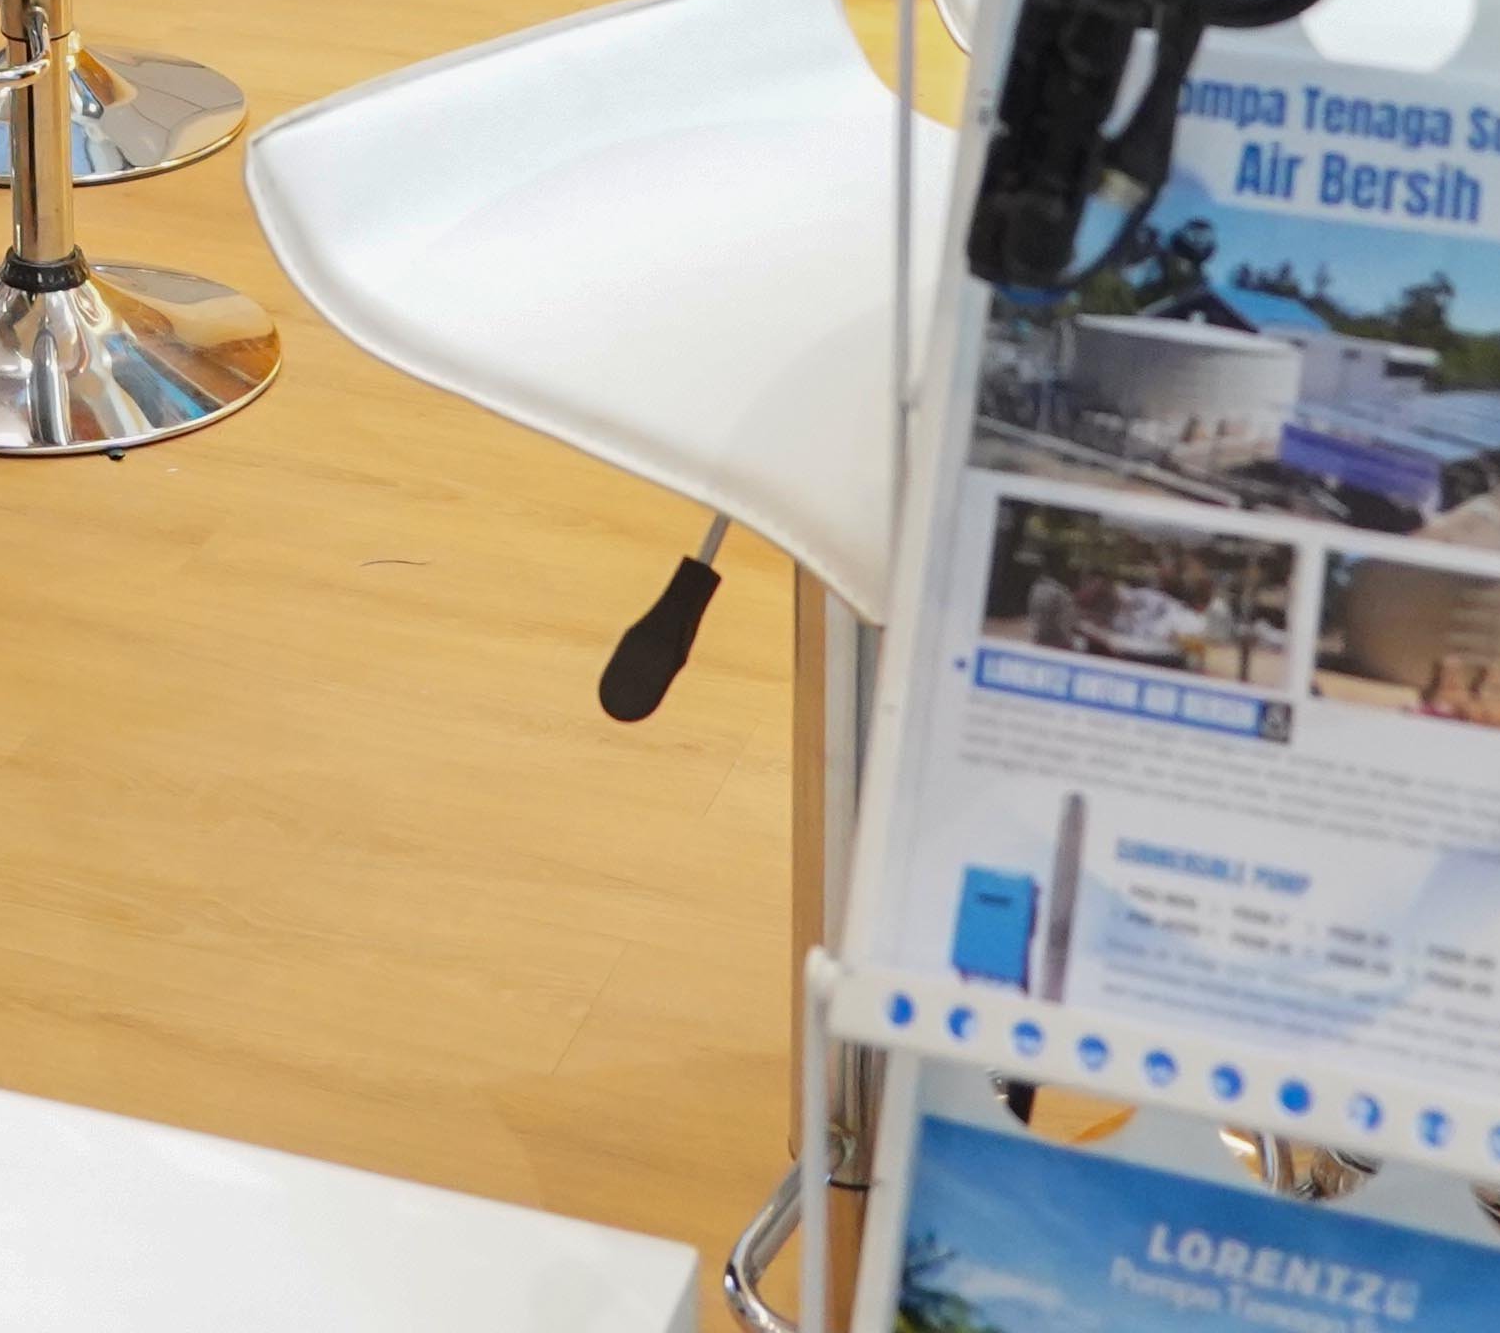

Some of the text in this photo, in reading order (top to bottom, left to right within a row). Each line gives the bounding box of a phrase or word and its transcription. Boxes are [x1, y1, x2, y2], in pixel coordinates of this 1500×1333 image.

[1180, 75, 1287, 130] ompa
[1303, 83, 1454, 149] Tenaga
[1235, 140, 1483, 224] Air Bersih
[1147, 1222, 1385, 1314] LORENTZ
